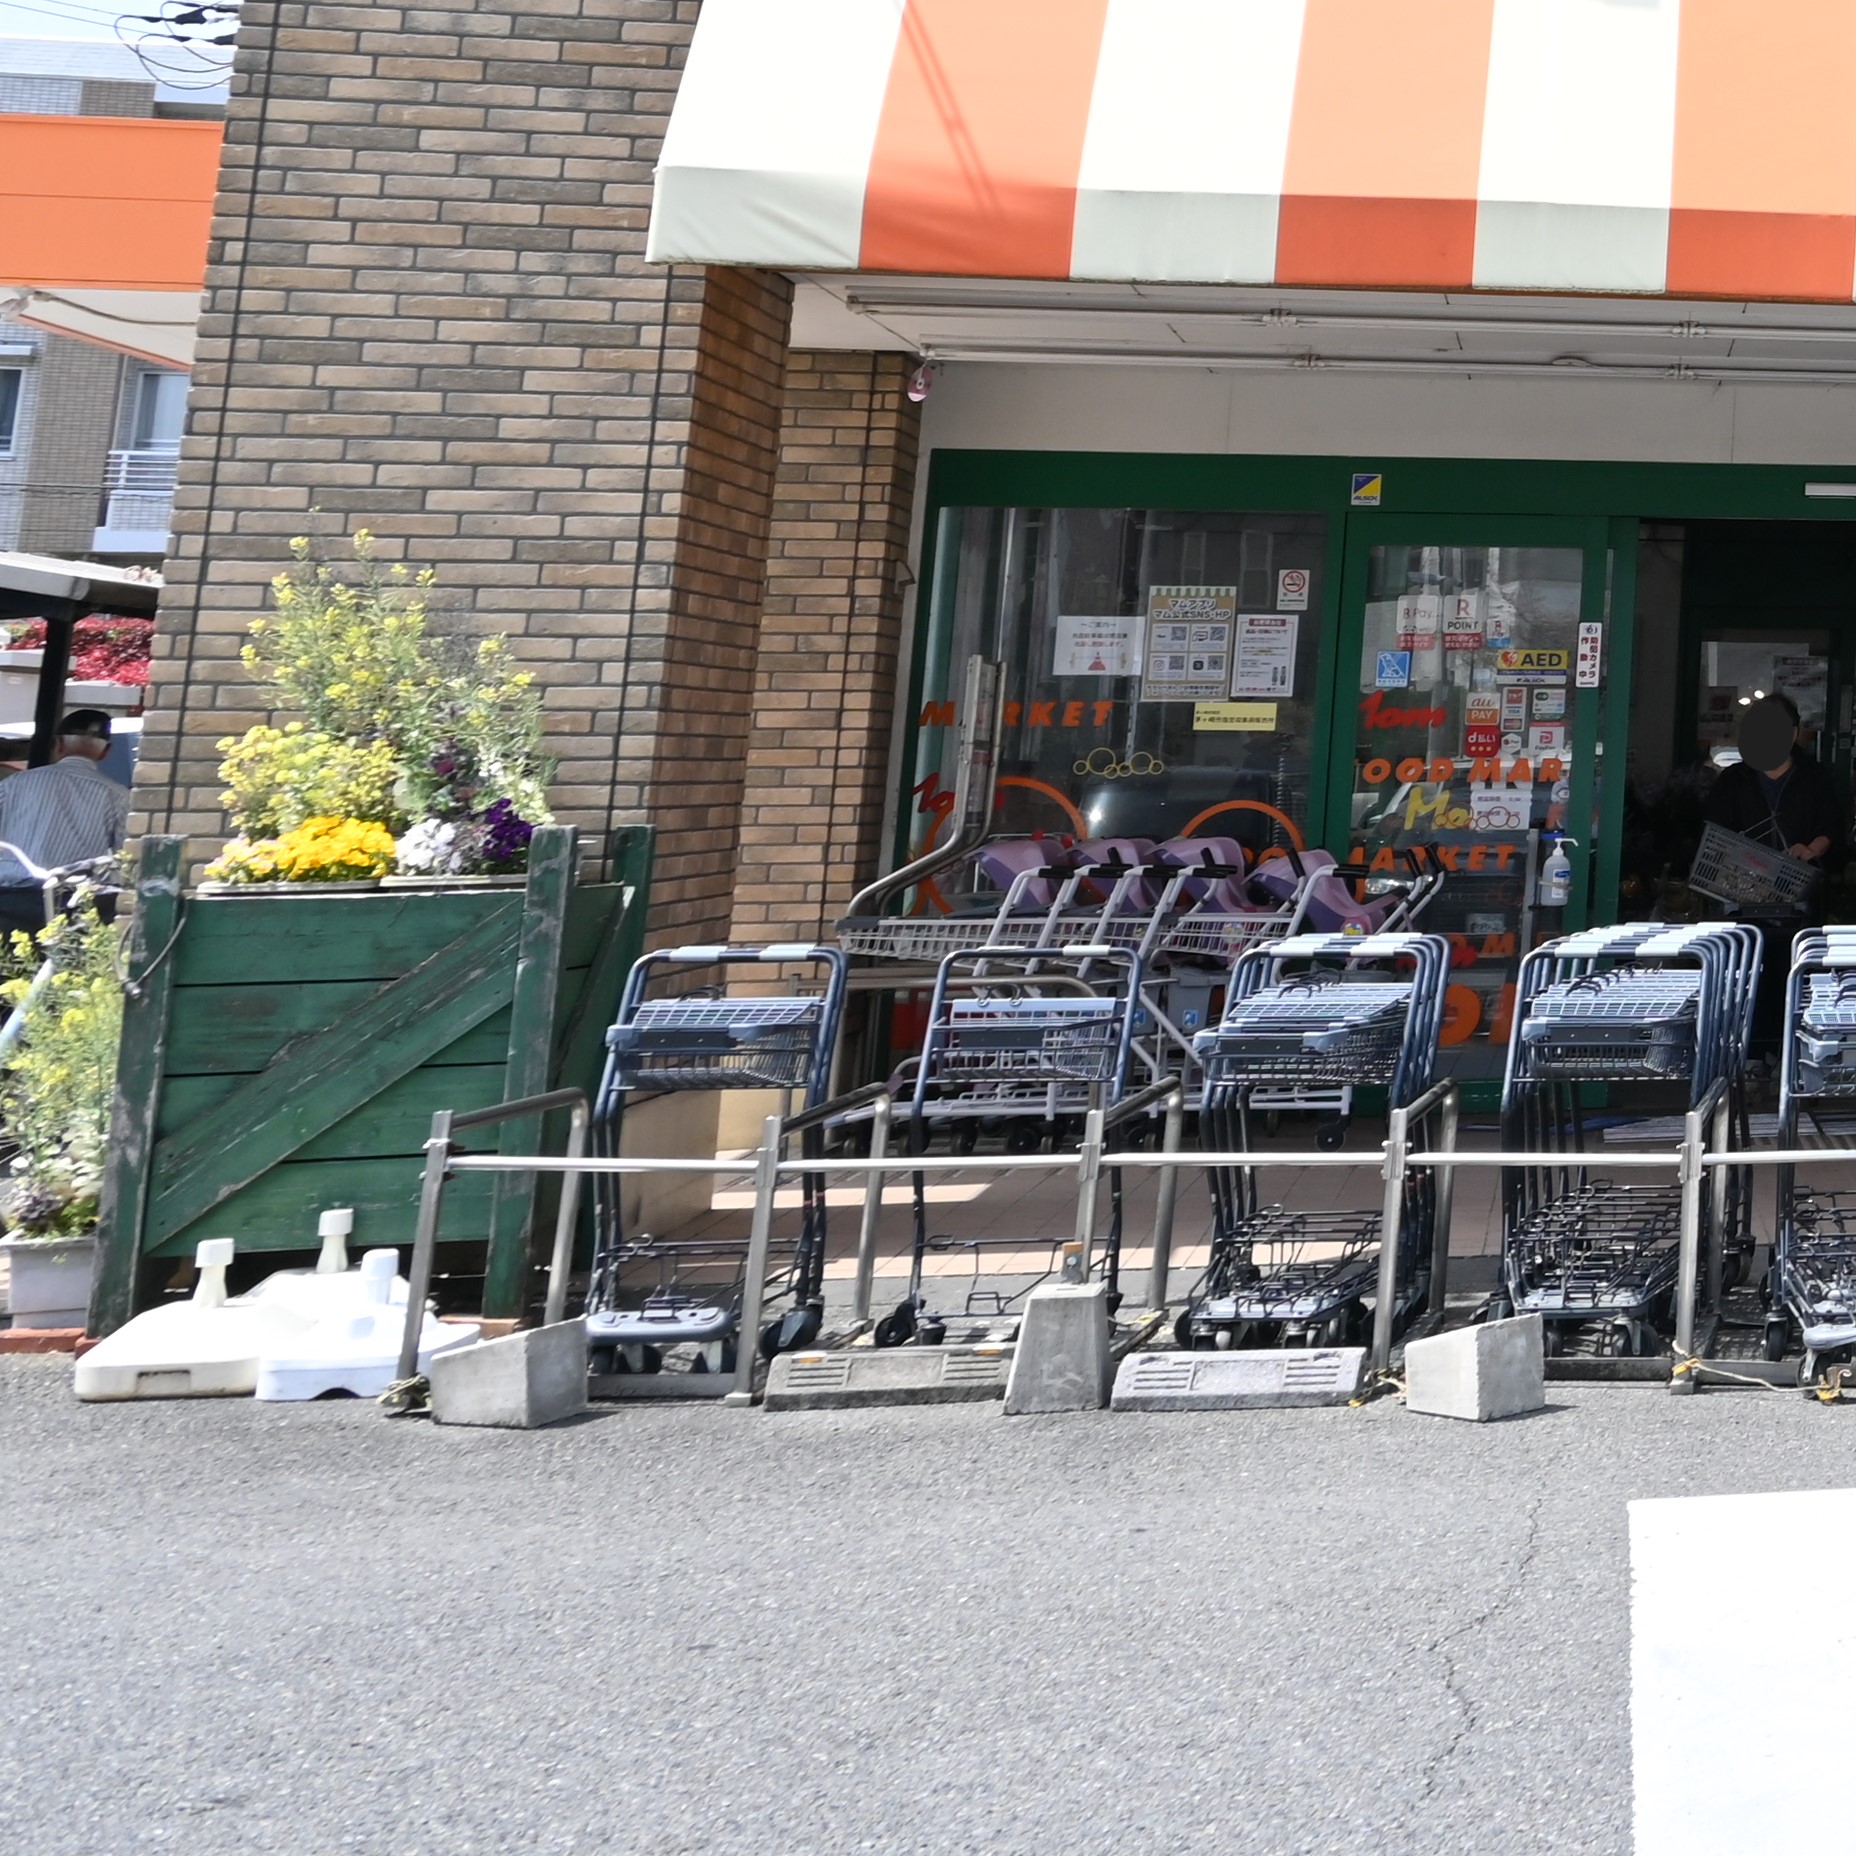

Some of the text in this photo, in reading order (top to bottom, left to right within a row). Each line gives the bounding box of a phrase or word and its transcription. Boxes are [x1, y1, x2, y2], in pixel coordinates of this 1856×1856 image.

[1456, 598, 1471, 616] R
[1447, 621, 1479, 630] POINT
[1520, 653, 1562, 667] AED
[918, 700, 1115, 727] MRKET
[1471, 710, 1493, 720] PAY
[1361, 757, 1455, 785] OOD
[1403, 786, 1472, 831] Mo
